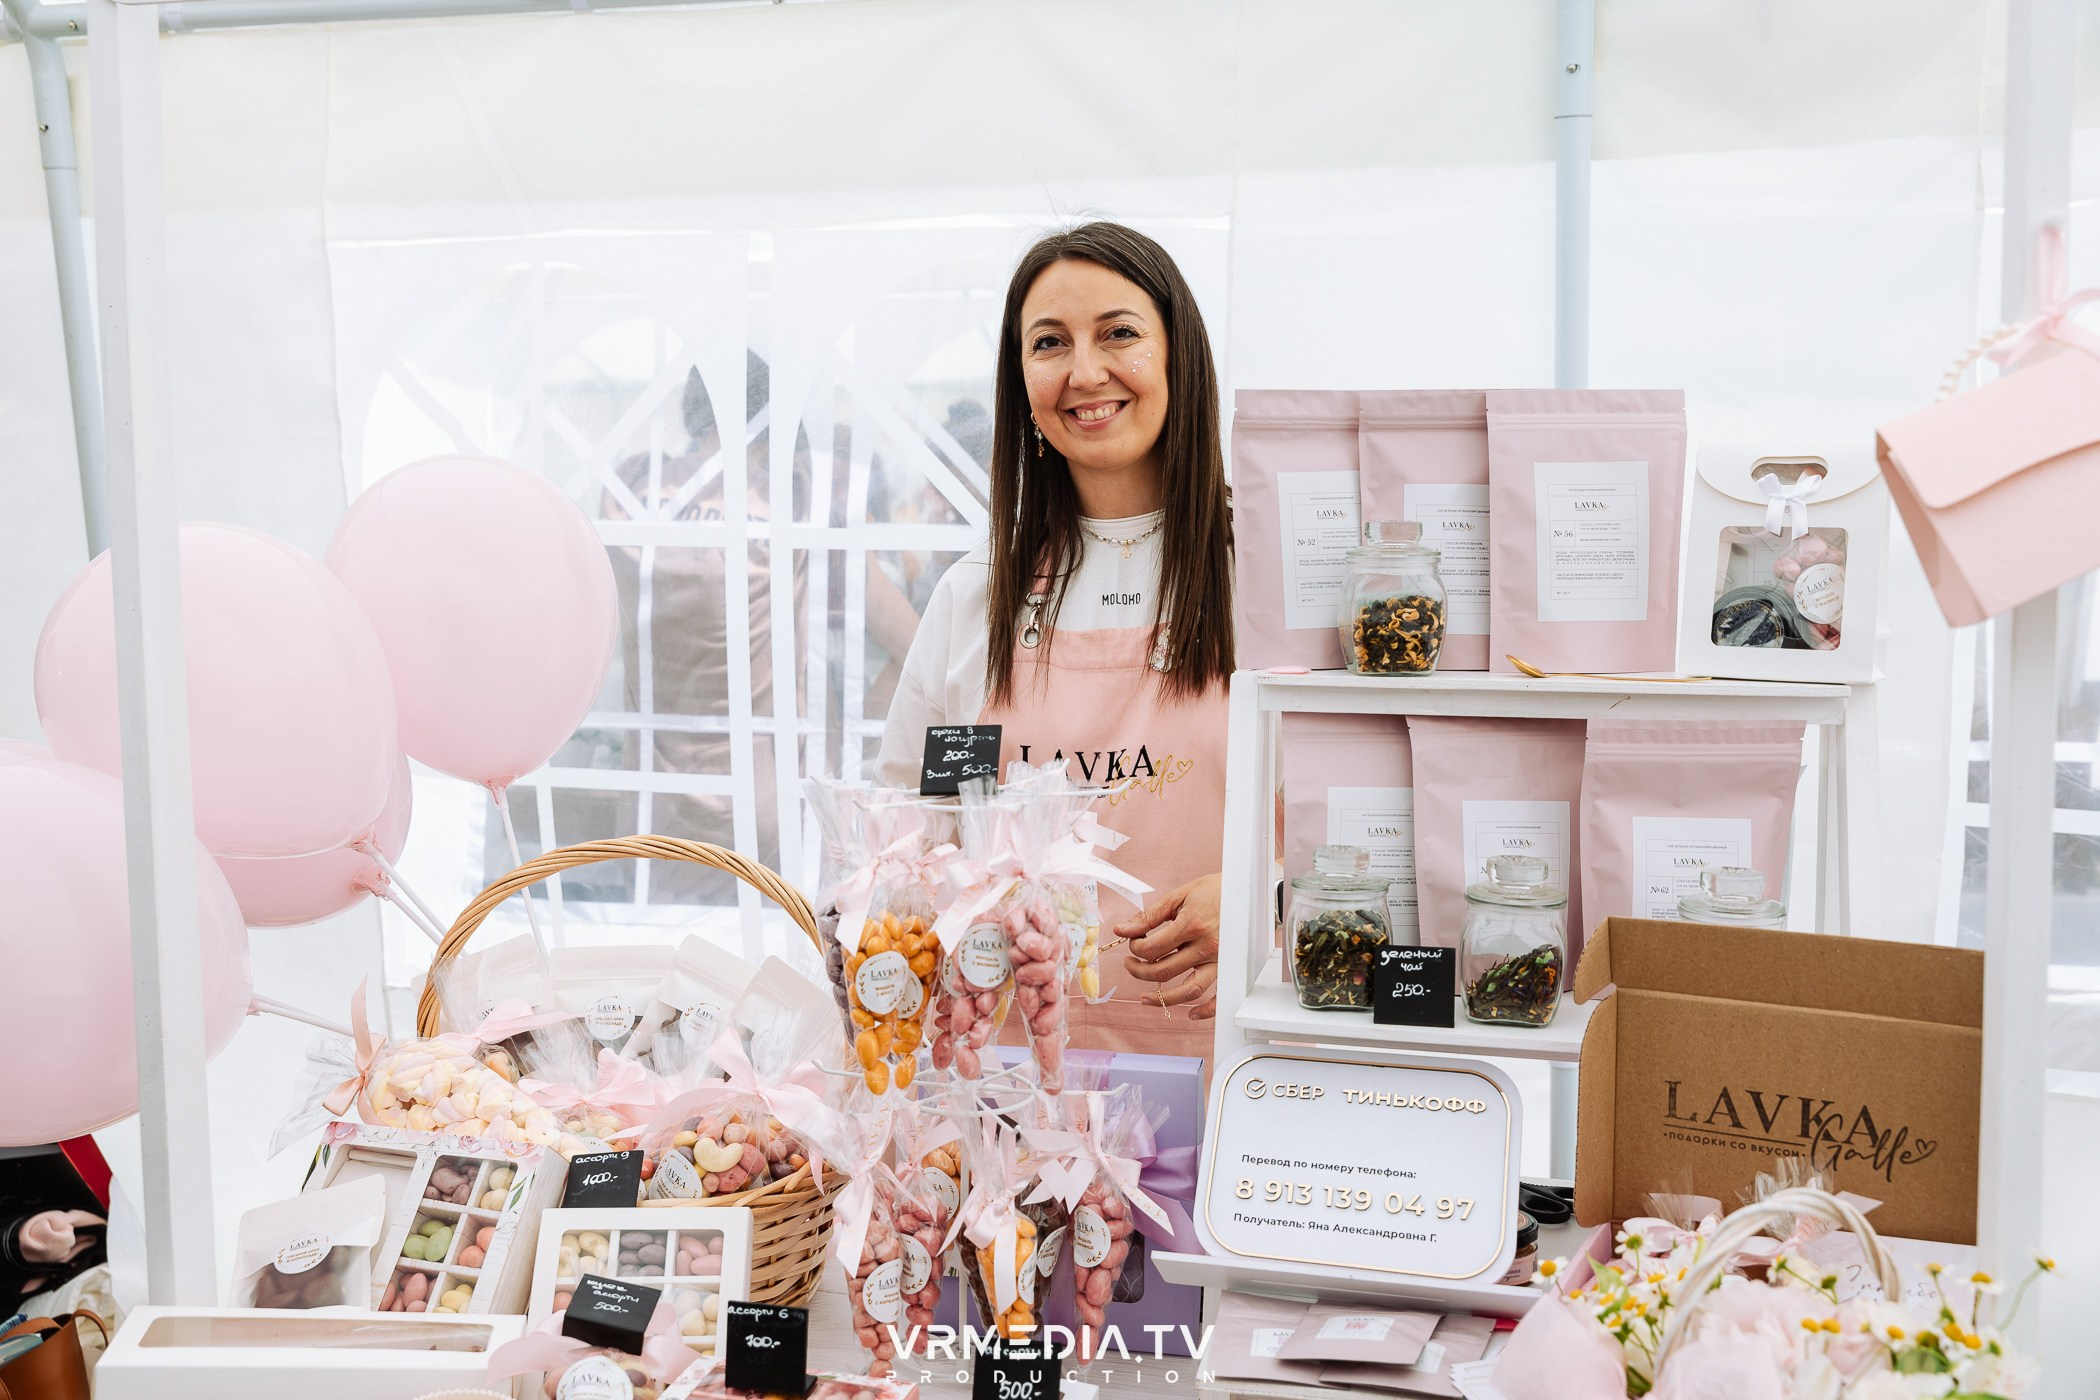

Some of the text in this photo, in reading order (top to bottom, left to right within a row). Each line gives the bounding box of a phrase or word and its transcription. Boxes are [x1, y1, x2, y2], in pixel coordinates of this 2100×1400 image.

[1574, 501, 1604, 510] LAVKA
[1807, 577, 1834, 592] LAVKA
[1101, 592, 1141, 606] MOLOKO
[972, 938, 1002, 950] LAVKA
[1380, 949, 1443, 966] зеленый
[1401, 962, 1423, 971] чай
[1272, 1083, 1487, 1114] СБЕР ТИНЬКОФФ
[1664, 1080, 1878, 1148] LAVKA
[1730, 1140, 1747, 1151] со
[1241, 1154, 1417, 1178] Перевод по номеру телефона:
[1234, 1177, 1476, 1220] 8 913 139 04 97
[1233, 1212, 1437, 1243] Получатель: Яна Александровна Г.
[289, 1237, 318, 1250] LAVKA
[778, 1308, 788, 1319] 6
[572, 1373, 610, 1387] LAVKA
